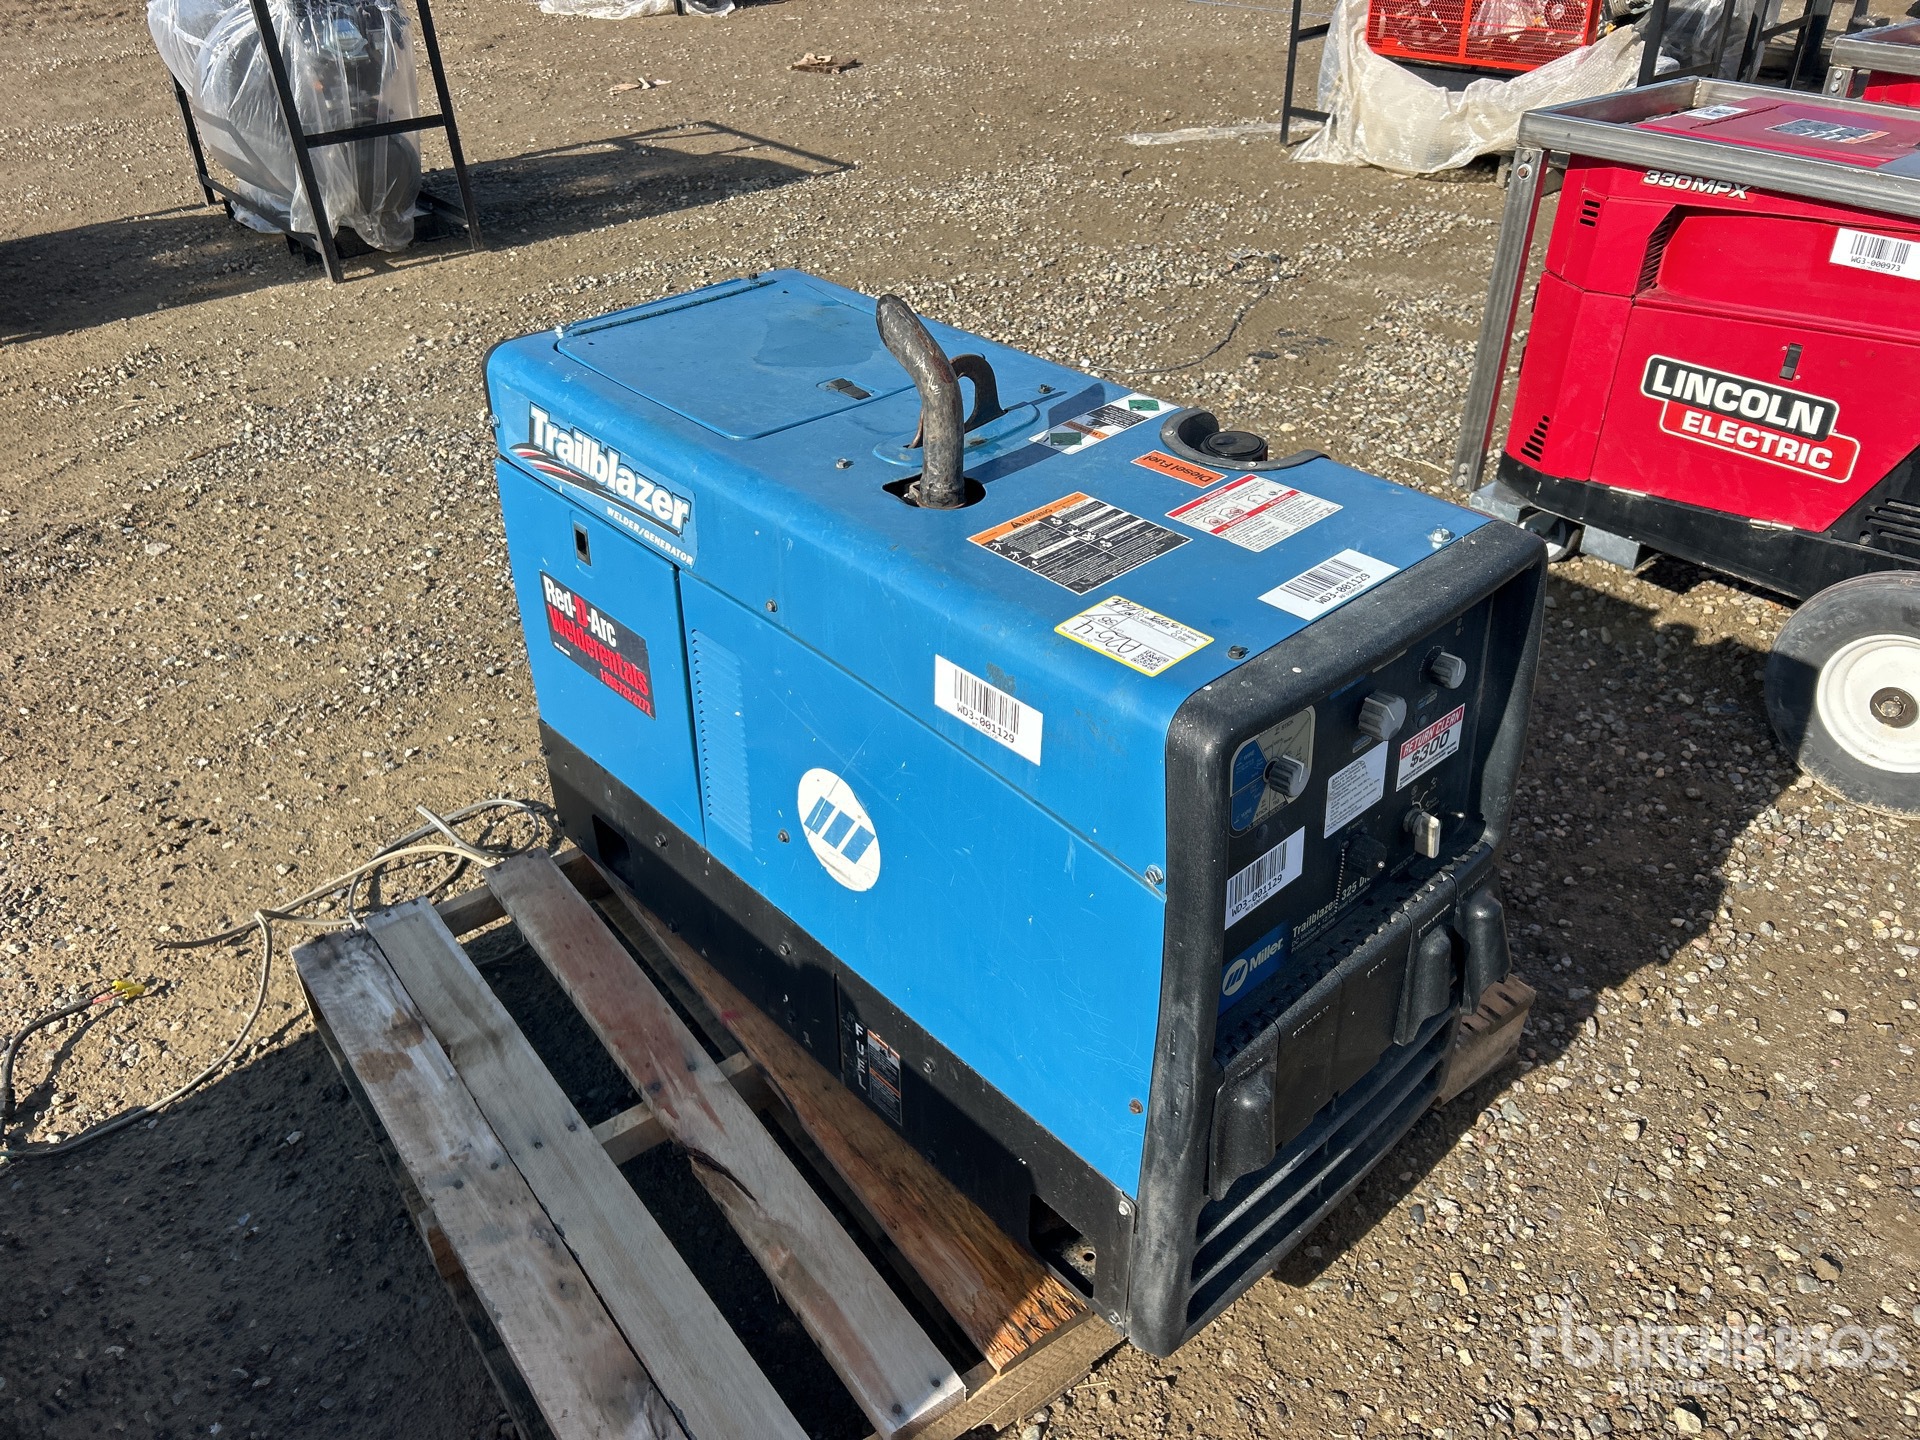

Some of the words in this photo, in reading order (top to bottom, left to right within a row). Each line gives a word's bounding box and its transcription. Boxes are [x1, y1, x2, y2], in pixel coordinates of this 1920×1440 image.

[1643, 169, 1749, 200] 330MPX
[1851, 256, 1901, 272] WG3-000973
[1651, 364, 1825, 435] LINCOLN
[1143, 454, 1174, 469] Fuel
[1681, 414, 1834, 471] ELECTRIC
[530, 403, 691, 533] Trailblazer
[1170, 461, 1214, 483] Diesel
[606, 506, 694, 566] WELDER/GENERATOR
[1315, 572, 1371, 605] WD3-001129
[543, 575, 617, 648] Red-D-Arc
[547, 604, 649, 696] Welderentals
[956, 702, 1015, 743] WD3-001129
[1403, 725, 1436, 757] RETURN
[1435, 708, 1463, 734] CLEAN
[1410, 729, 1450, 768] $300
[1231, 873, 1283, 917] WD3-001129
[1341, 881, 1358, 901] 325
[1249, 937, 1284, 973] Miller
[854, 1022, 867, 1091] FUEL
